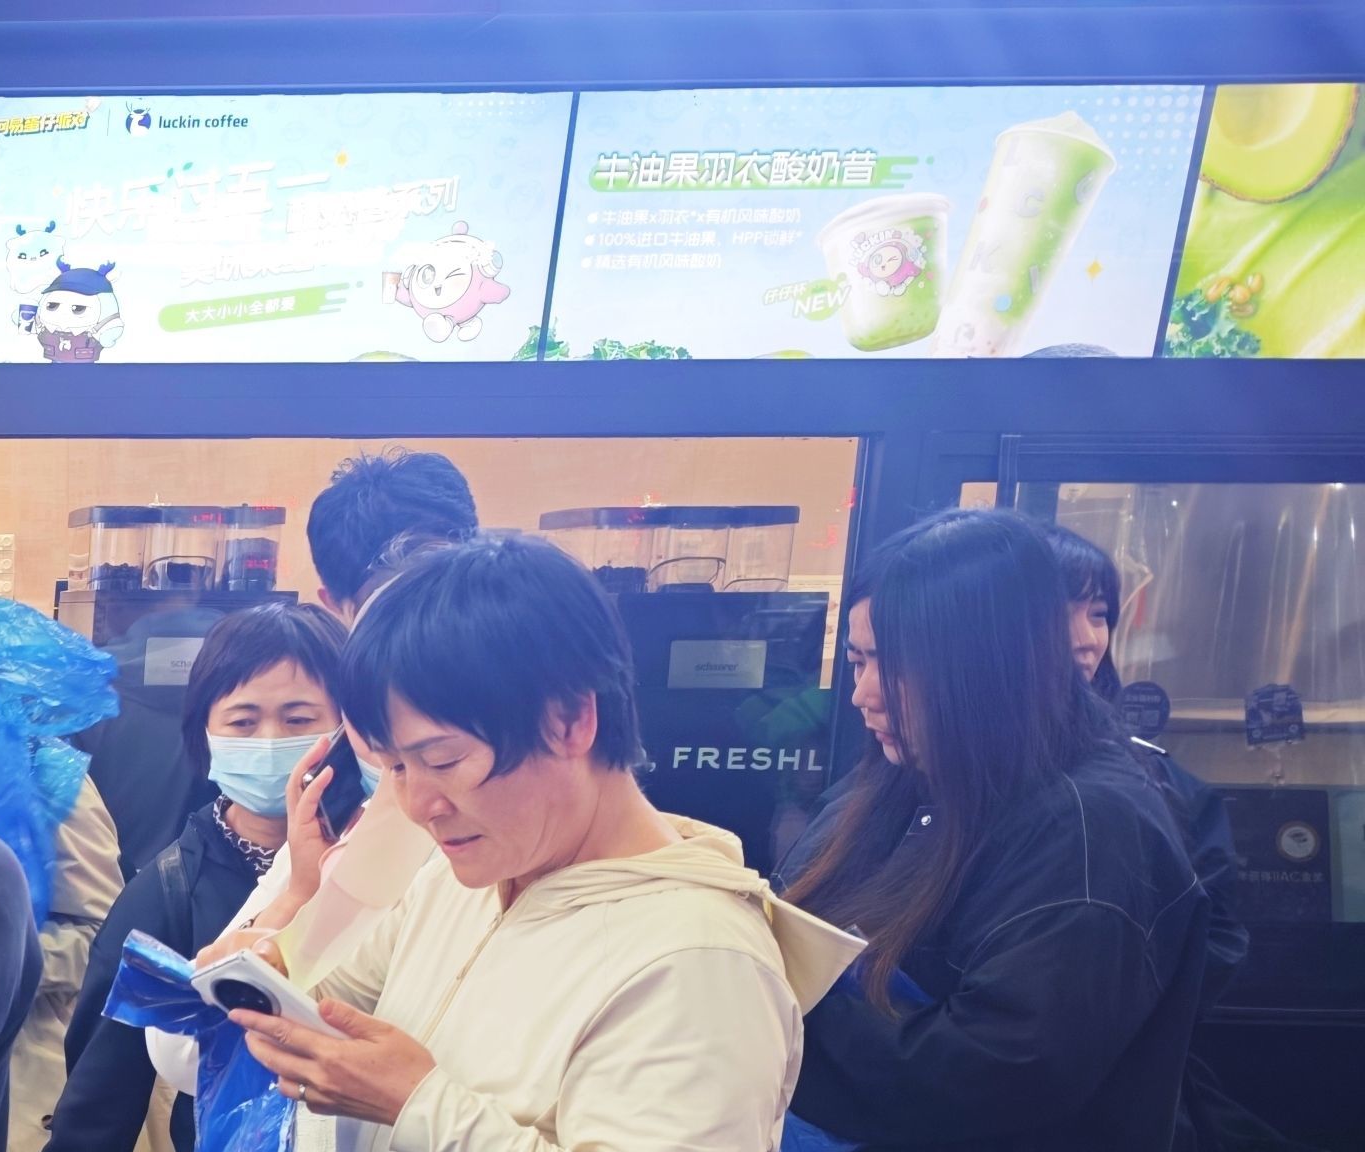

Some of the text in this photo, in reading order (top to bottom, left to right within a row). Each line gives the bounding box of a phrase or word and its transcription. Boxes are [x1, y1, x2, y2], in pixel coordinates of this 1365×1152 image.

[158, 115, 249, 129] luckin coffee
[594, 150, 878, 189] 牛油果羽衣酸奶昔
[793, 286, 851, 318] NEW
[672, 746, 824, 771] FRESHL
